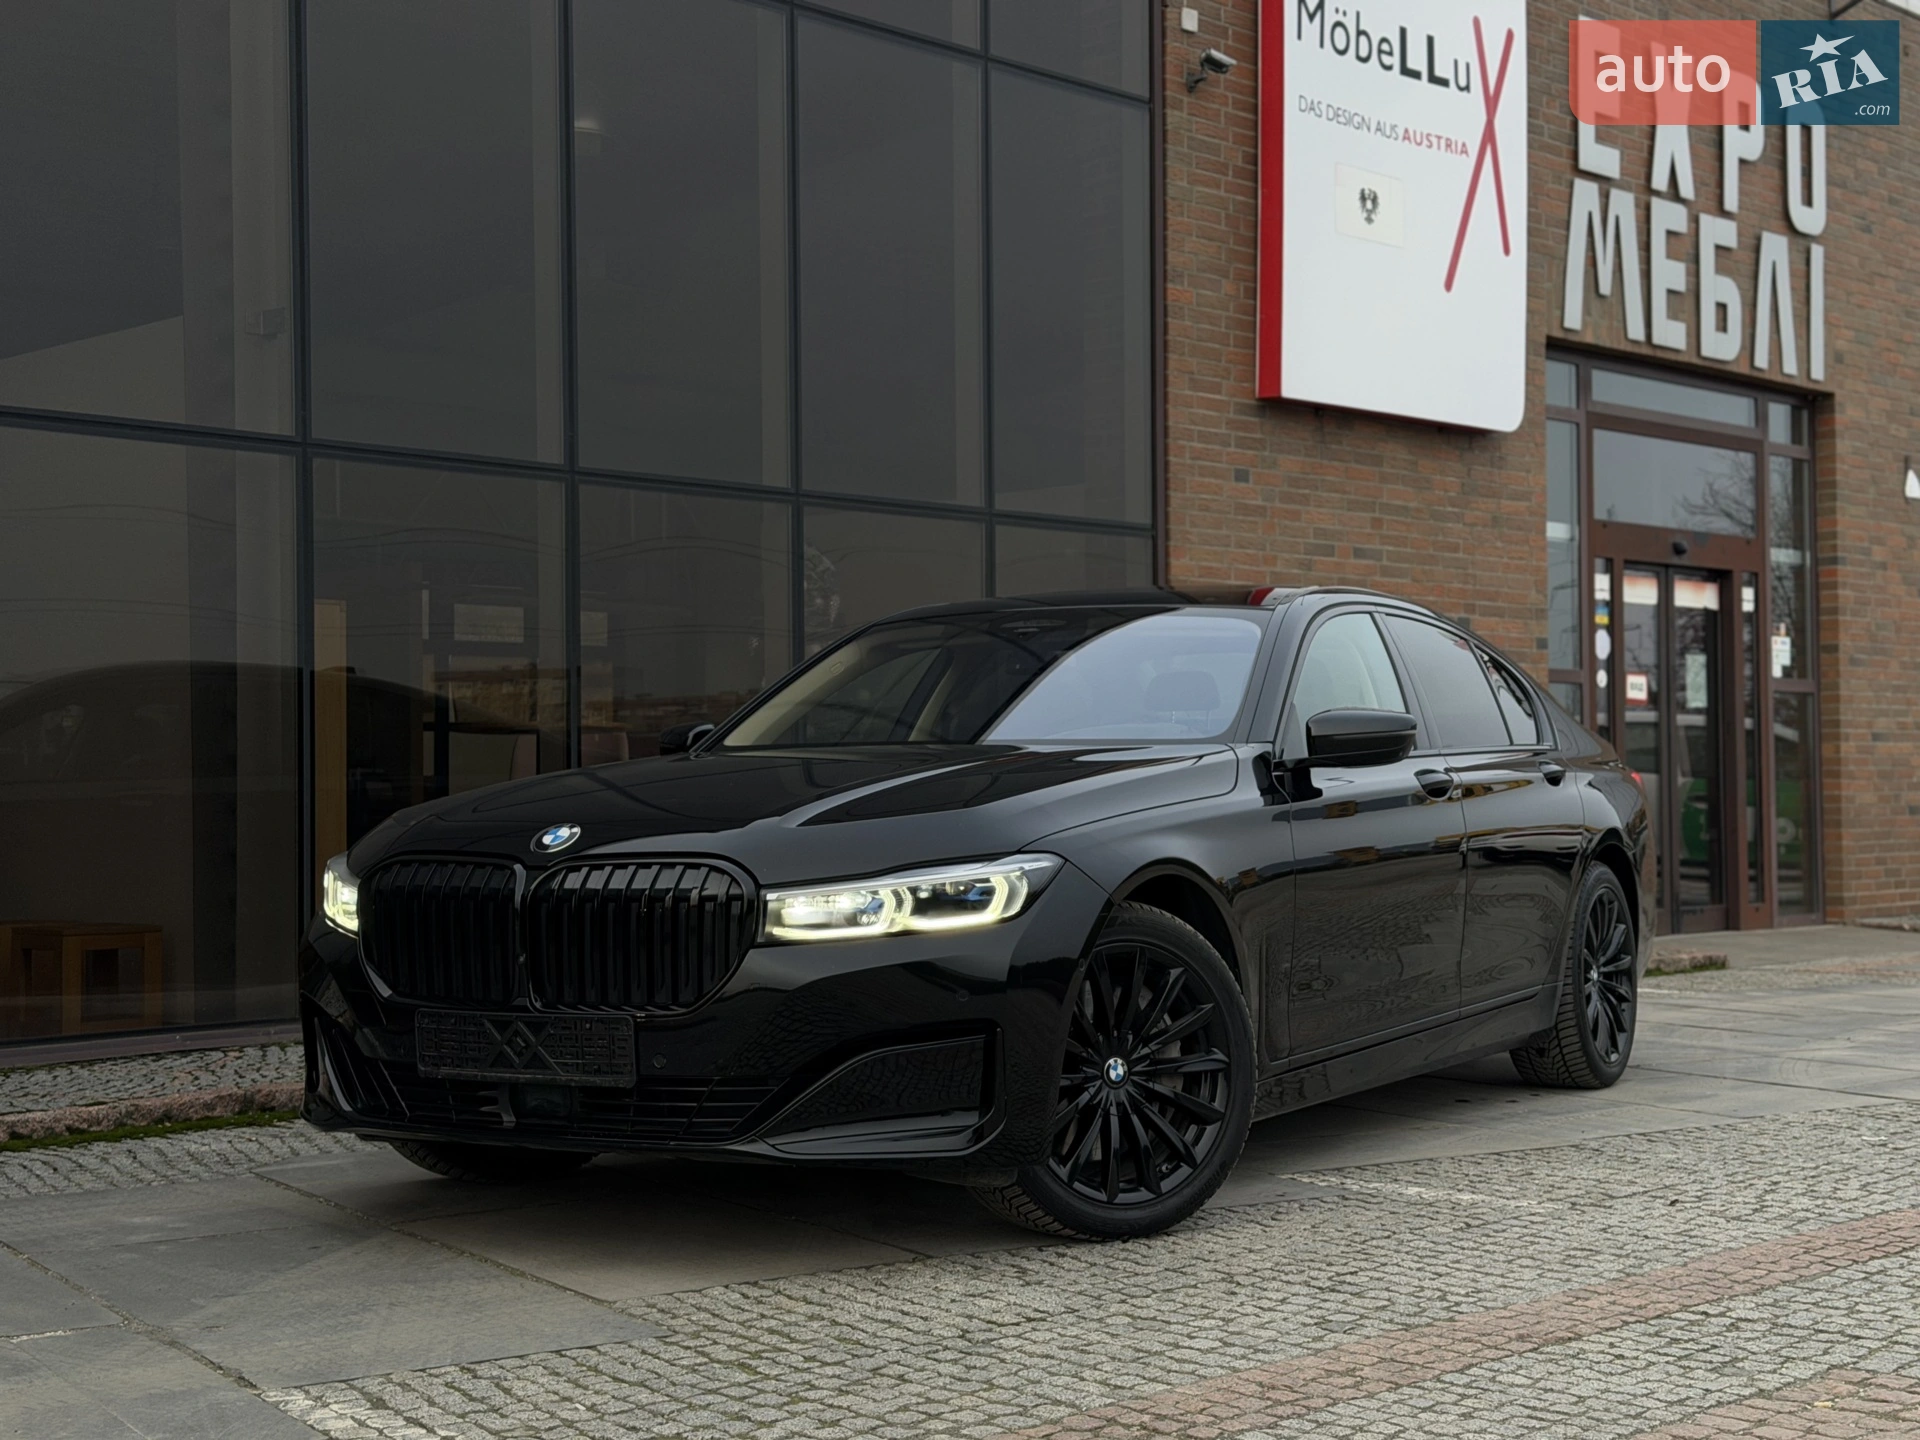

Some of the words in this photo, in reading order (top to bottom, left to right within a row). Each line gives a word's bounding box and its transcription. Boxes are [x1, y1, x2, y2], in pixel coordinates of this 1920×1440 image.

[1298, 95, 1323, 119] DAS
[1326, 103, 1371, 133] DESIGN
[1374, 119, 1399, 141] AUS
[1402, 127, 1470, 158] AUSTRIA
[1563, 178, 1825, 382] МЕБЛІ
